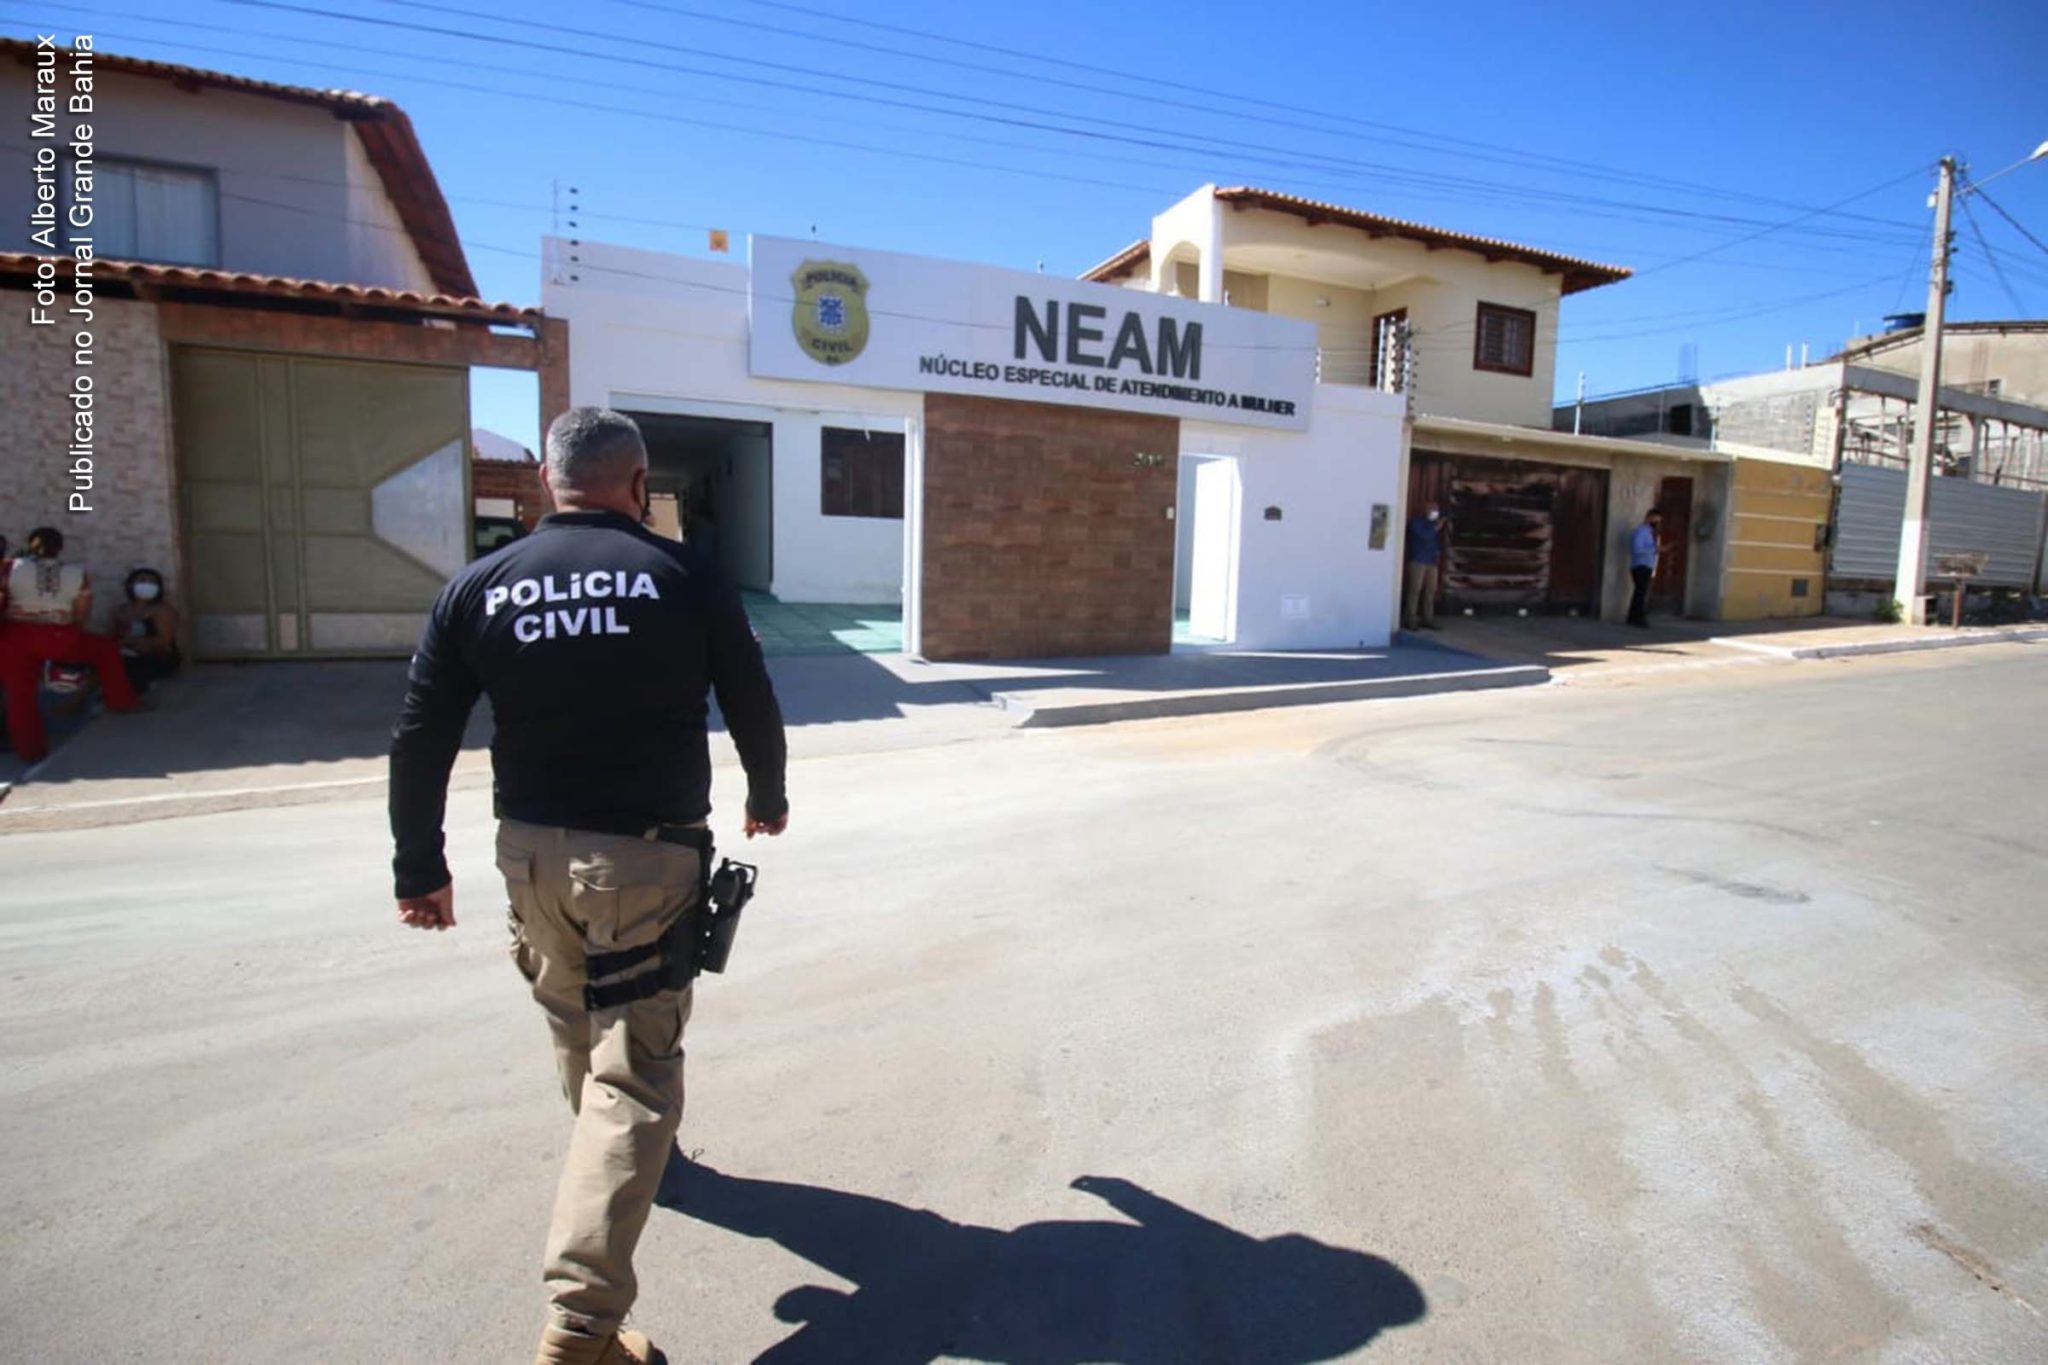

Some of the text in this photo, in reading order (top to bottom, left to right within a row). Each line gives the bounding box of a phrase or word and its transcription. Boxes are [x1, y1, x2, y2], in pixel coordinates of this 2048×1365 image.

[812, 338, 854, 353] CIVIL
[1014, 295, 1203, 381] NEAM
[919, 354, 1296, 416] NÚCLEO ESPECIAL DE ATENDIMENTO A MULHER
[514, 606, 630, 643] CIVIL
